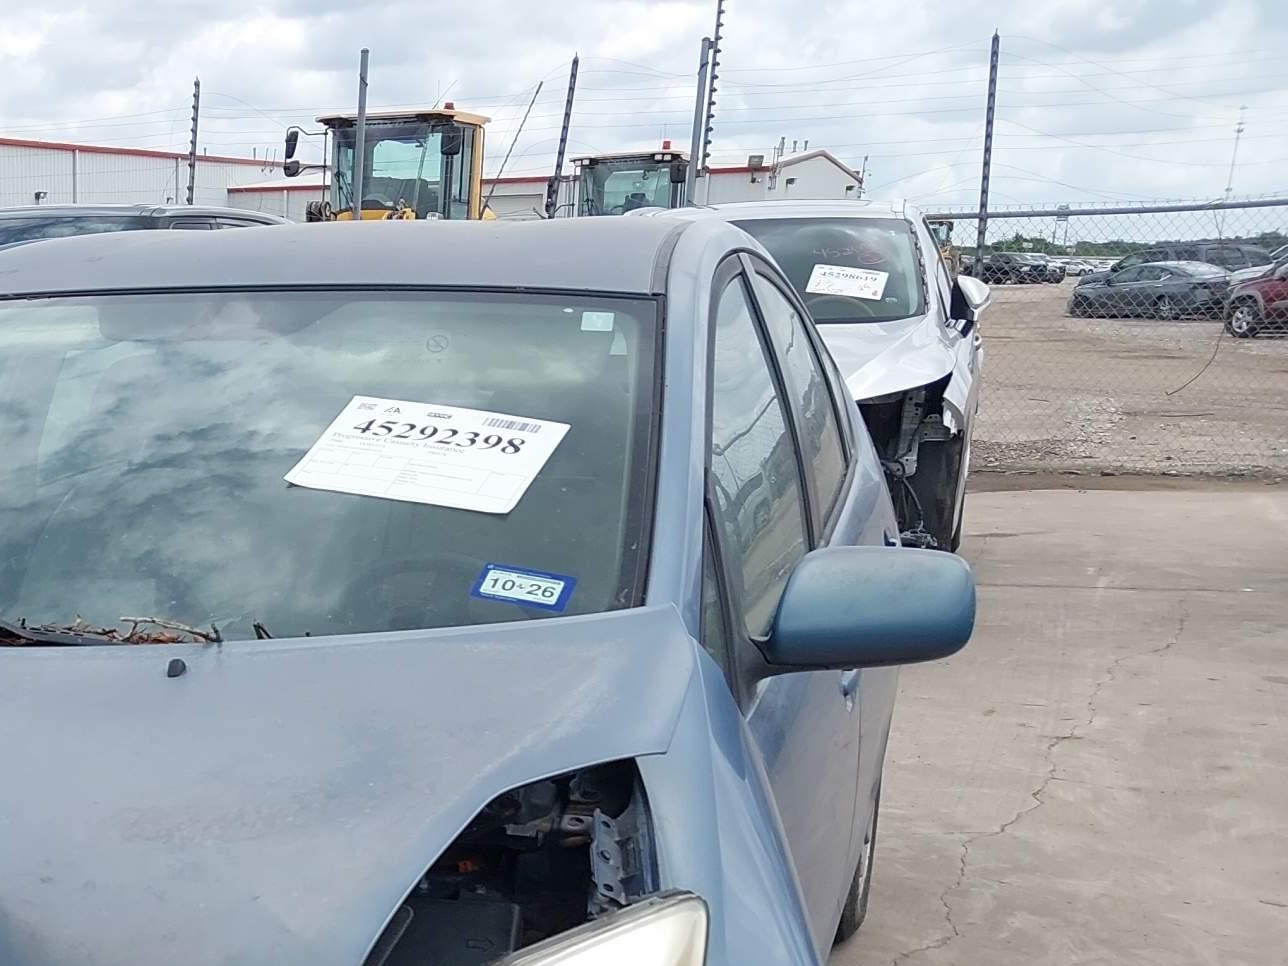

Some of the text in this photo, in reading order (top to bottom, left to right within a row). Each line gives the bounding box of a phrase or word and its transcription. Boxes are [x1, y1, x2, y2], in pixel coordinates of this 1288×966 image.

[352, 418, 527, 455] 45292398
[489, 577, 516, 592] 10
[526, 583, 557, 599] 26
